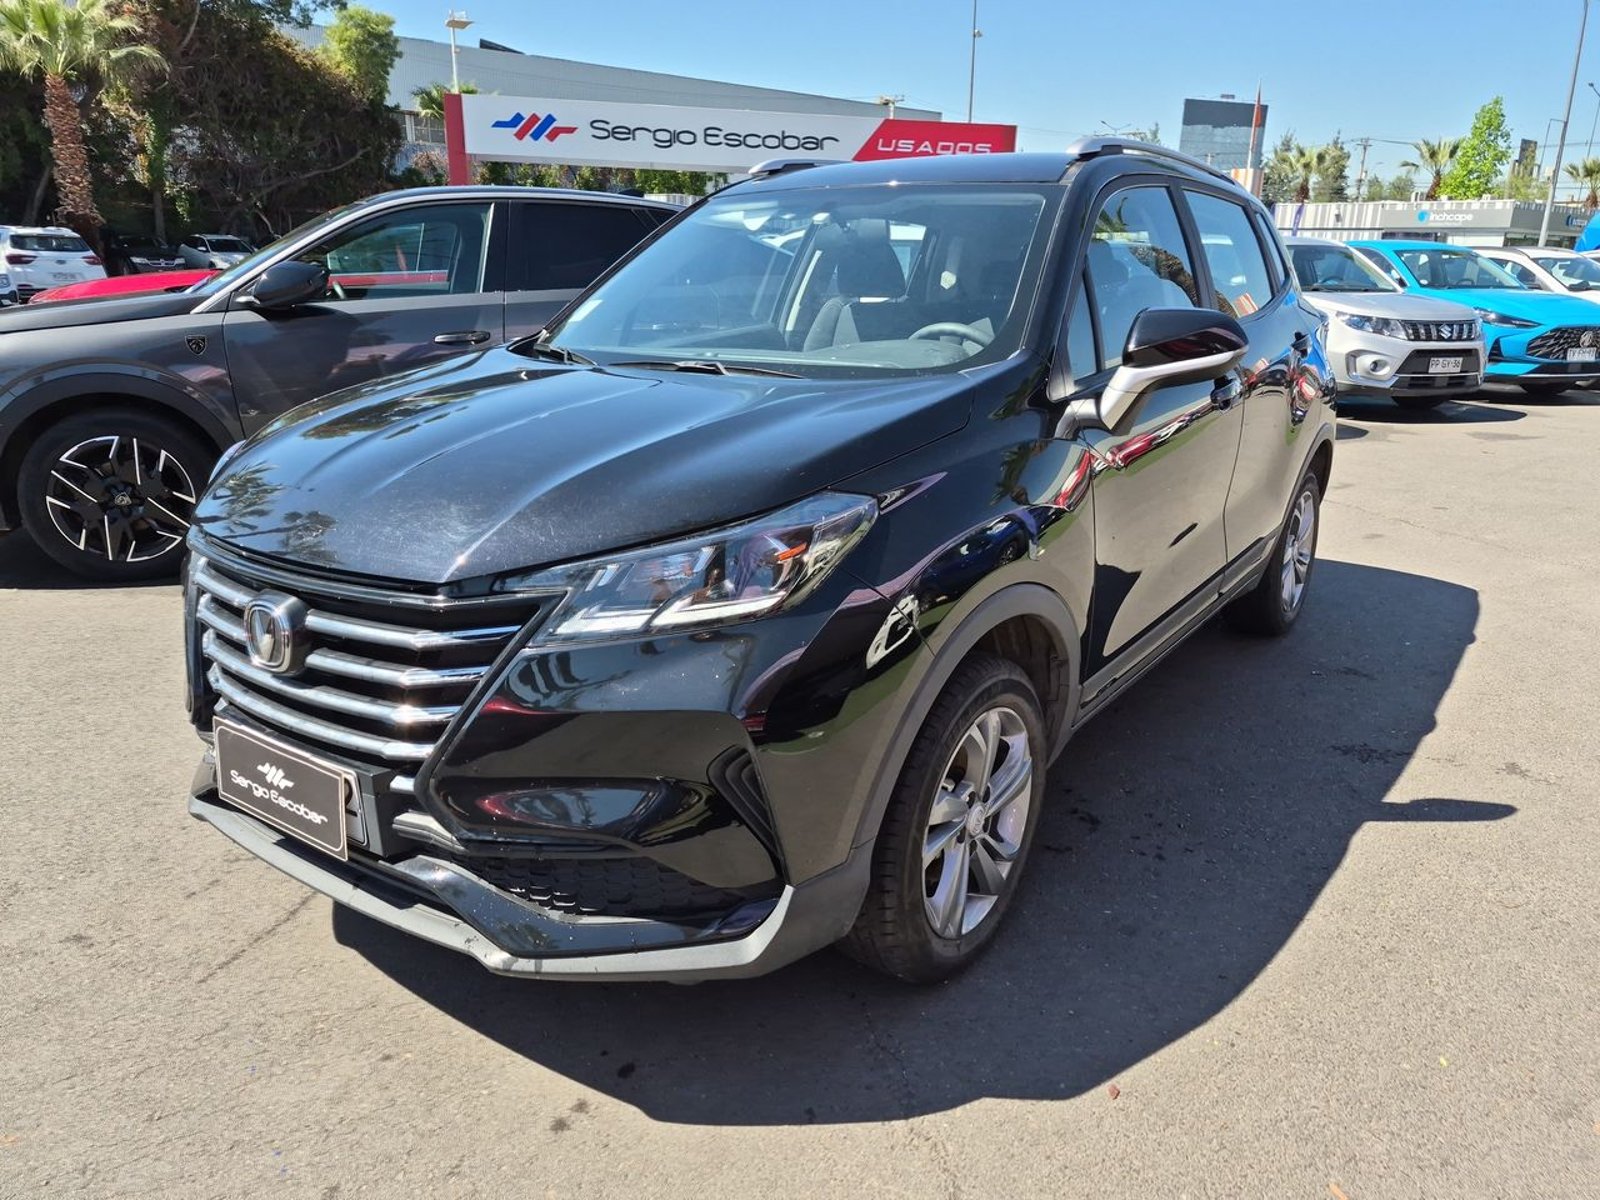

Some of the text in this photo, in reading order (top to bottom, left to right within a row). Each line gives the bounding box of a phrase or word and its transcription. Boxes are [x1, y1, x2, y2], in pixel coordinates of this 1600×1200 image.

[590, 119, 839, 151] Sergio Escobar
[877, 138, 992, 154] USADOS
[270, 789, 328, 825] Escobar
